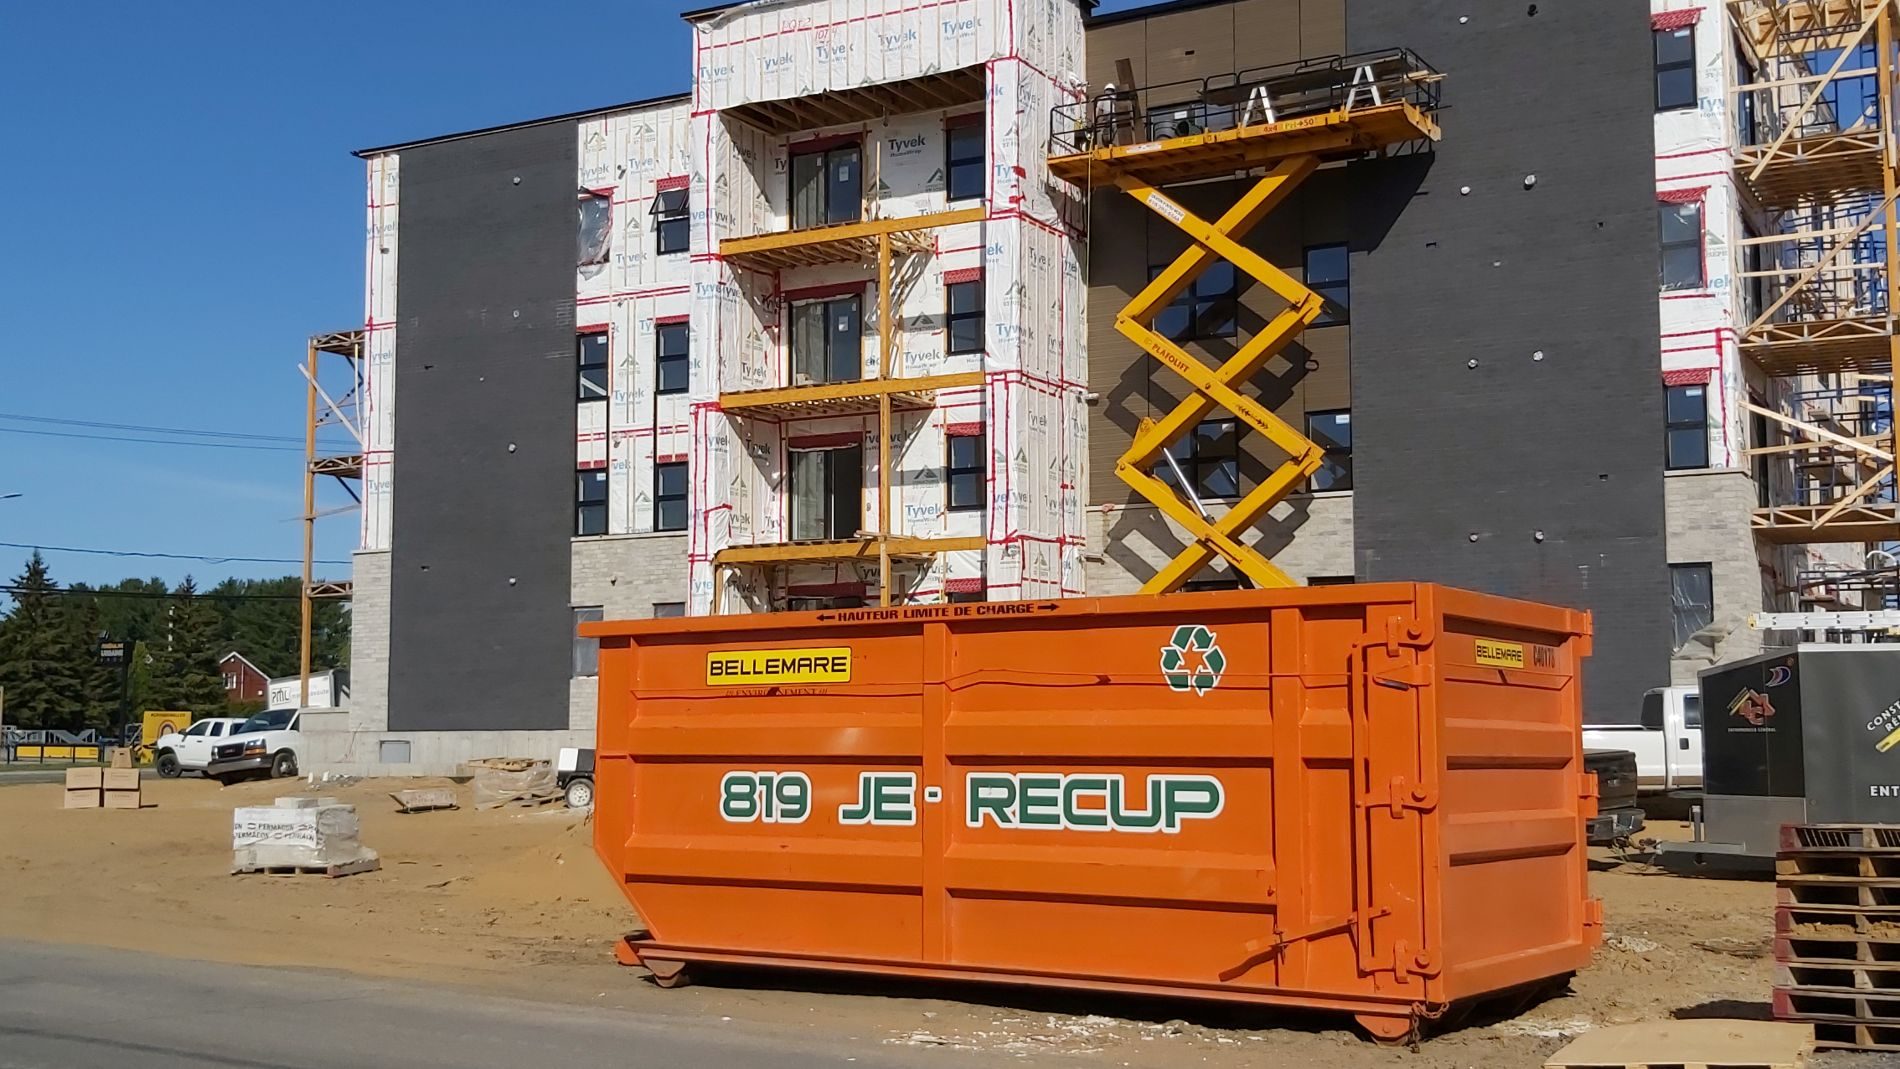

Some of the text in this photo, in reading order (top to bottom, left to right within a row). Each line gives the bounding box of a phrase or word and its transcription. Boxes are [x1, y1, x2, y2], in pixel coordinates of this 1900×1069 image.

[942, 17, 982, 35] Tyvek
[888, 134, 926, 151] Tyvek
[904, 349, 940, 364] Tyvek
[838, 603, 1034, 623] HAUTEUR LIMITE DE CHARGE
[1476, 645, 1522, 662] BELLEMARE
[710, 656, 848, 676] BELLEMARE
[721, 772, 811, 822] 819
[966, 772, 1225, 833] RECUP
